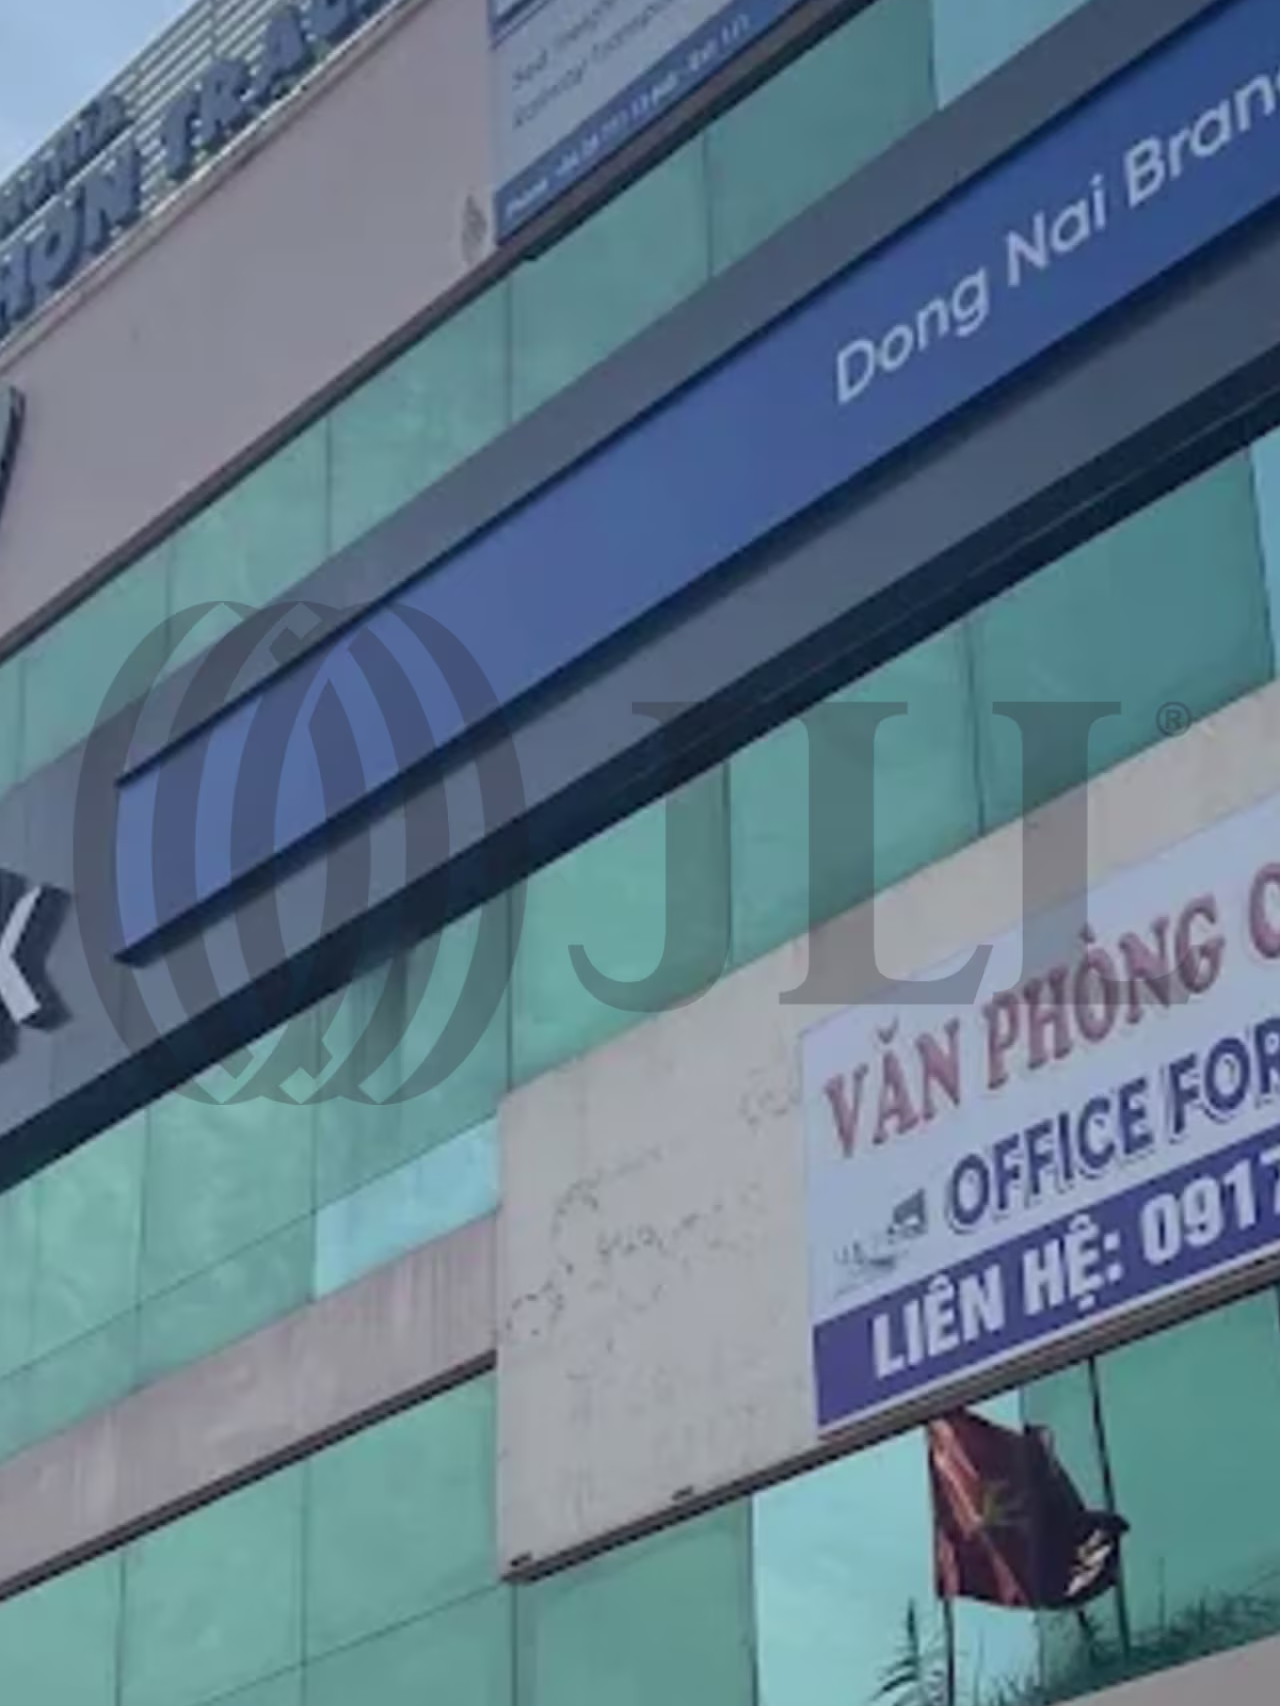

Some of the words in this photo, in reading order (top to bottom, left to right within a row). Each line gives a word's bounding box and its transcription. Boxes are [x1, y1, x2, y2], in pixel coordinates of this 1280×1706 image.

[835, 265, 991, 405] Dong
[1004, 173, 1109, 290] Nai
[823, 1018, 963, 1159] VĂN
[981, 891, 1227, 1091] PHÒNG
[950, 1076, 1156, 1234] OFFICE
[872, 1264, 1006, 1380] LIÊN
[1022, 1213, 1124, 1317] HỆ:
